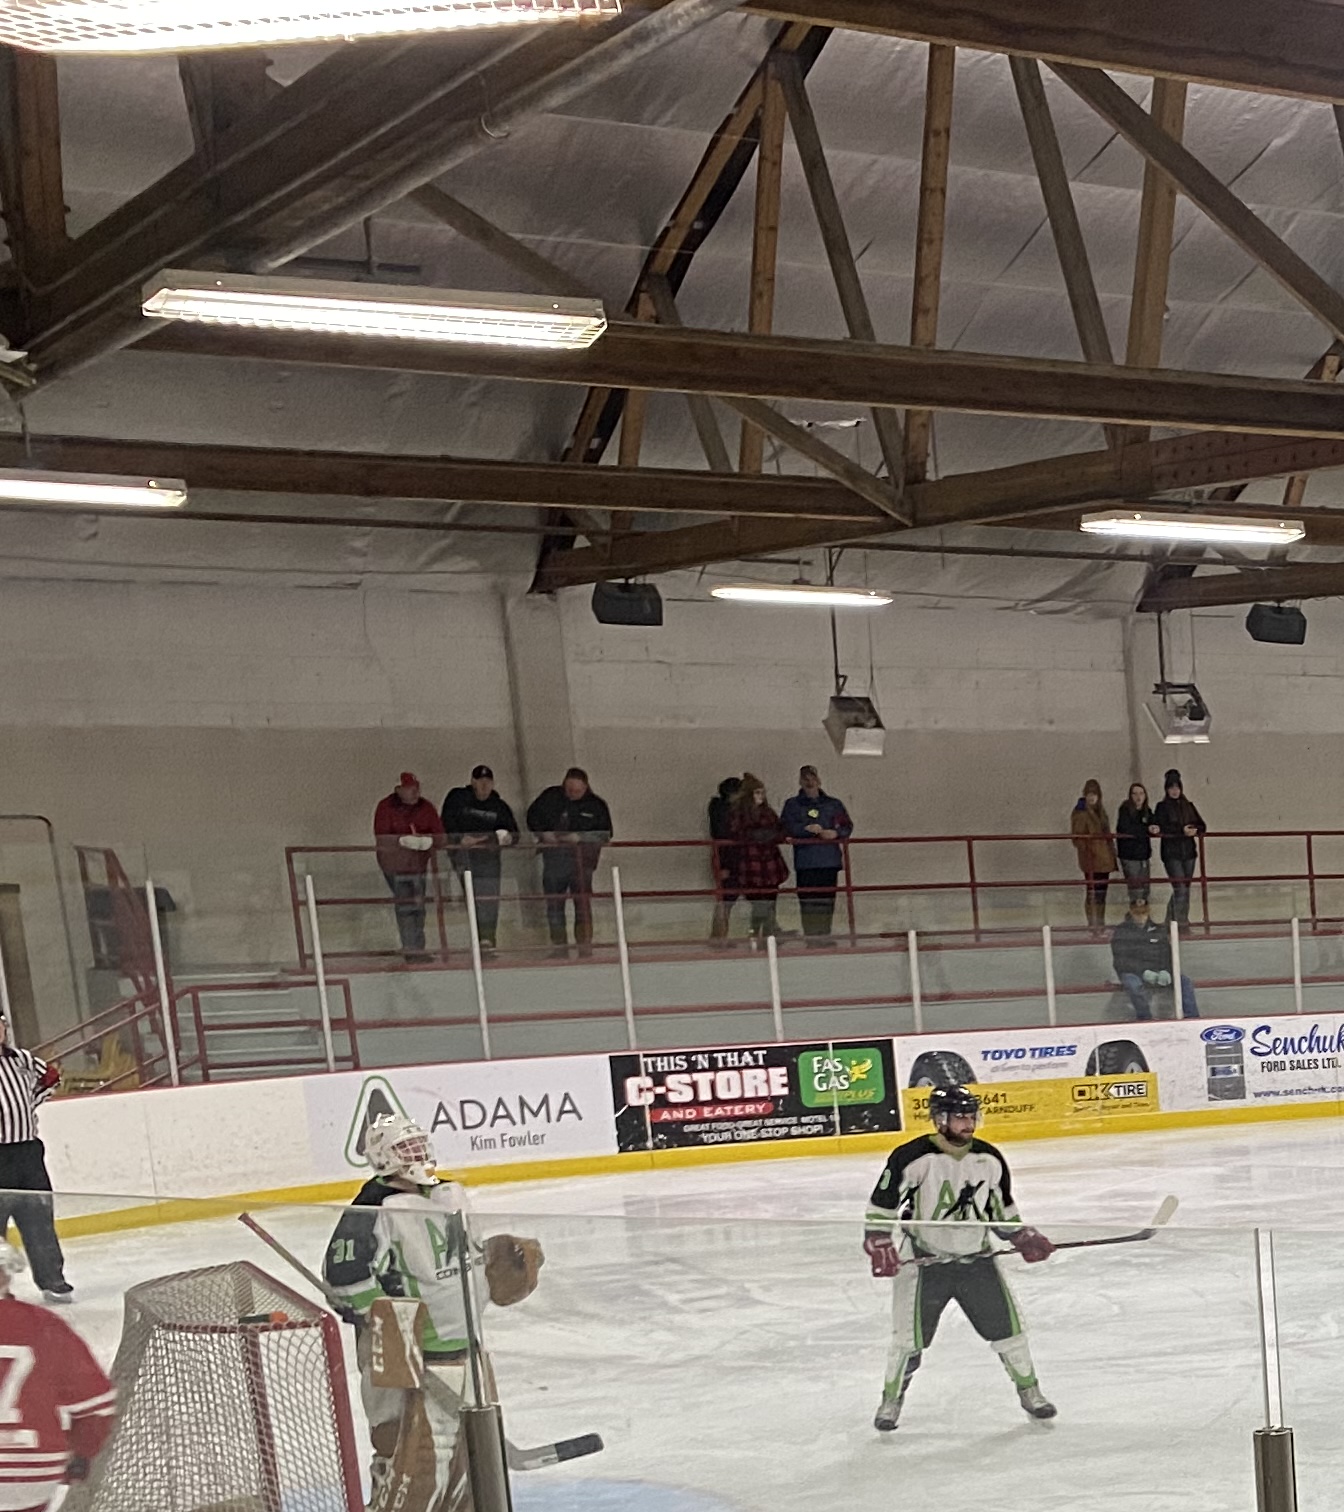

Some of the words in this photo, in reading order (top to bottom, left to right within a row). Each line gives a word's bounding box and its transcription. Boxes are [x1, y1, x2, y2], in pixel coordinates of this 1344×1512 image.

[643, 1055, 688, 1073] THIS
[712, 1050, 767, 1068] THAT
[980, 1048, 1026, 1061] TOYO
[1028, 1044, 1078, 1059] TIRES
[812, 1056, 843, 1073] FAS
[1260, 1060, 1286, 1073] FORD
[1289, 1058, 1319, 1071] SALES
[625, 1066, 790, 1107] C-STORE
[813, 1073, 850, 1092] GAS
[1113, 1083, 1145, 1096] TIRE
[844, 1087, 876, 1098] PLUS
[430, 1091, 583, 1134] ADAMA
[660, 1108, 696, 1121] AND
[703, 1103, 766, 1118] EATERY
[470, 1135, 496, 1151] Kim
[500, 1131, 547, 1149] Fowler
[702, 1130, 733, 1144] YOUR
[331, 1238, 356, 1264] 31
